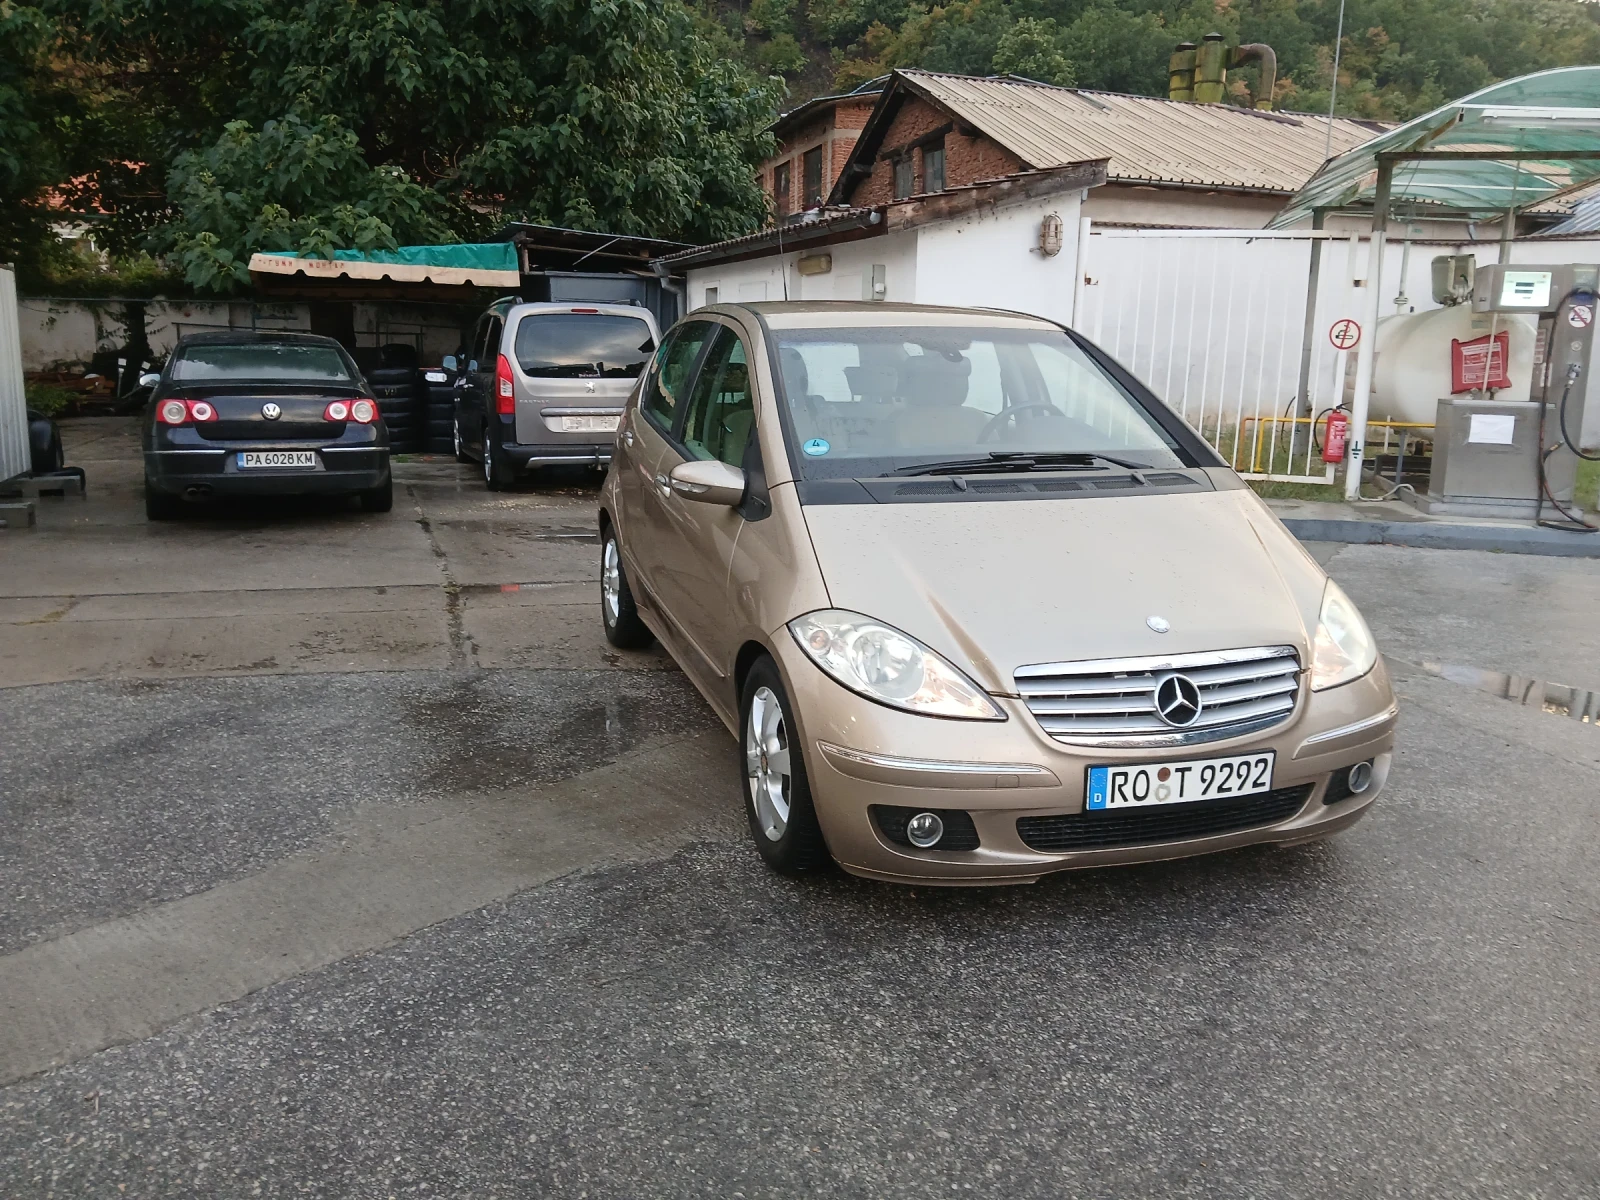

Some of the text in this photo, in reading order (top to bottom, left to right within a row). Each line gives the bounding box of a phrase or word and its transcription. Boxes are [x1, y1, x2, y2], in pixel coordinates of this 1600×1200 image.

[812, 439, 820, 447] 4
[245, 453, 262, 465] PA
[264, 453, 295, 465] 6028
[296, 453, 313, 465] KM
[1110, 757, 1269, 803] RO T 9292
[1093, 793, 1102, 803] D
